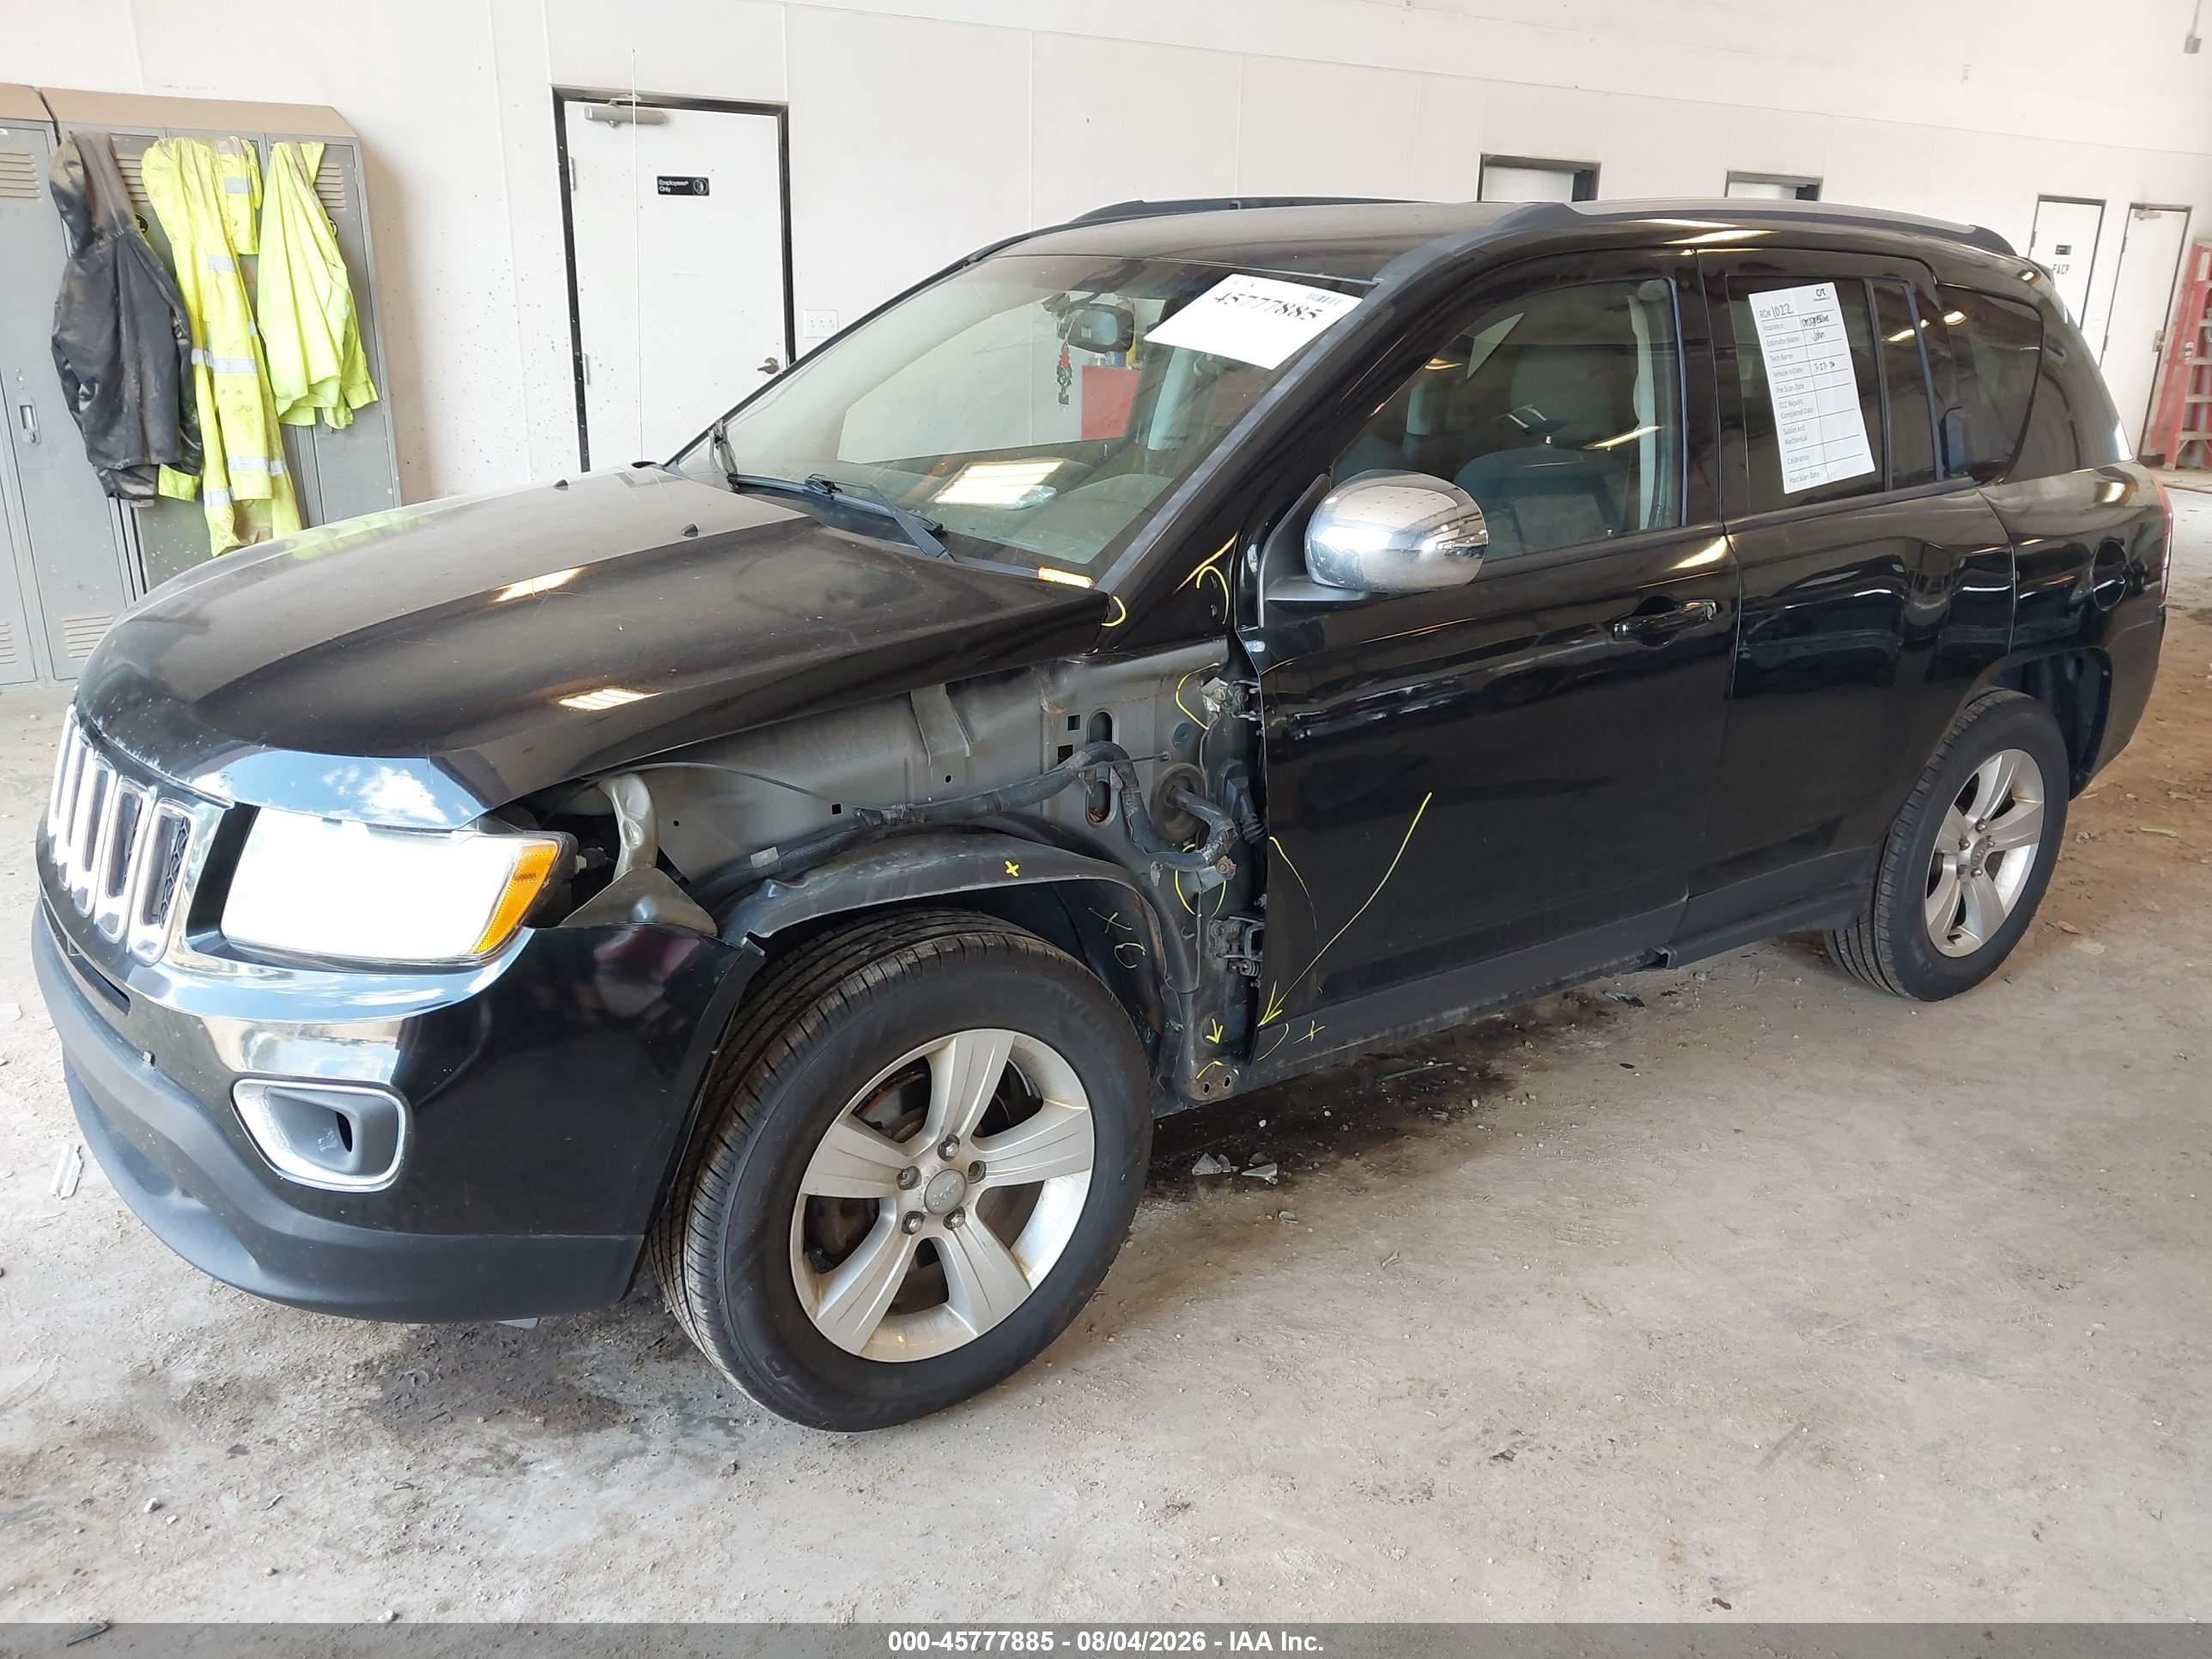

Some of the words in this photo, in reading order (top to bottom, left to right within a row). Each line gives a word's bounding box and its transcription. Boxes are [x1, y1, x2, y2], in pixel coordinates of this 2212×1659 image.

[1213, 292, 1323, 320] 45777885
[1771, 303, 1795, 319] 1022
[1784, 384, 1795, 392] Scan
[1797, 423, 1806, 432] and
[1784, 434, 1808, 445] Mechanical
